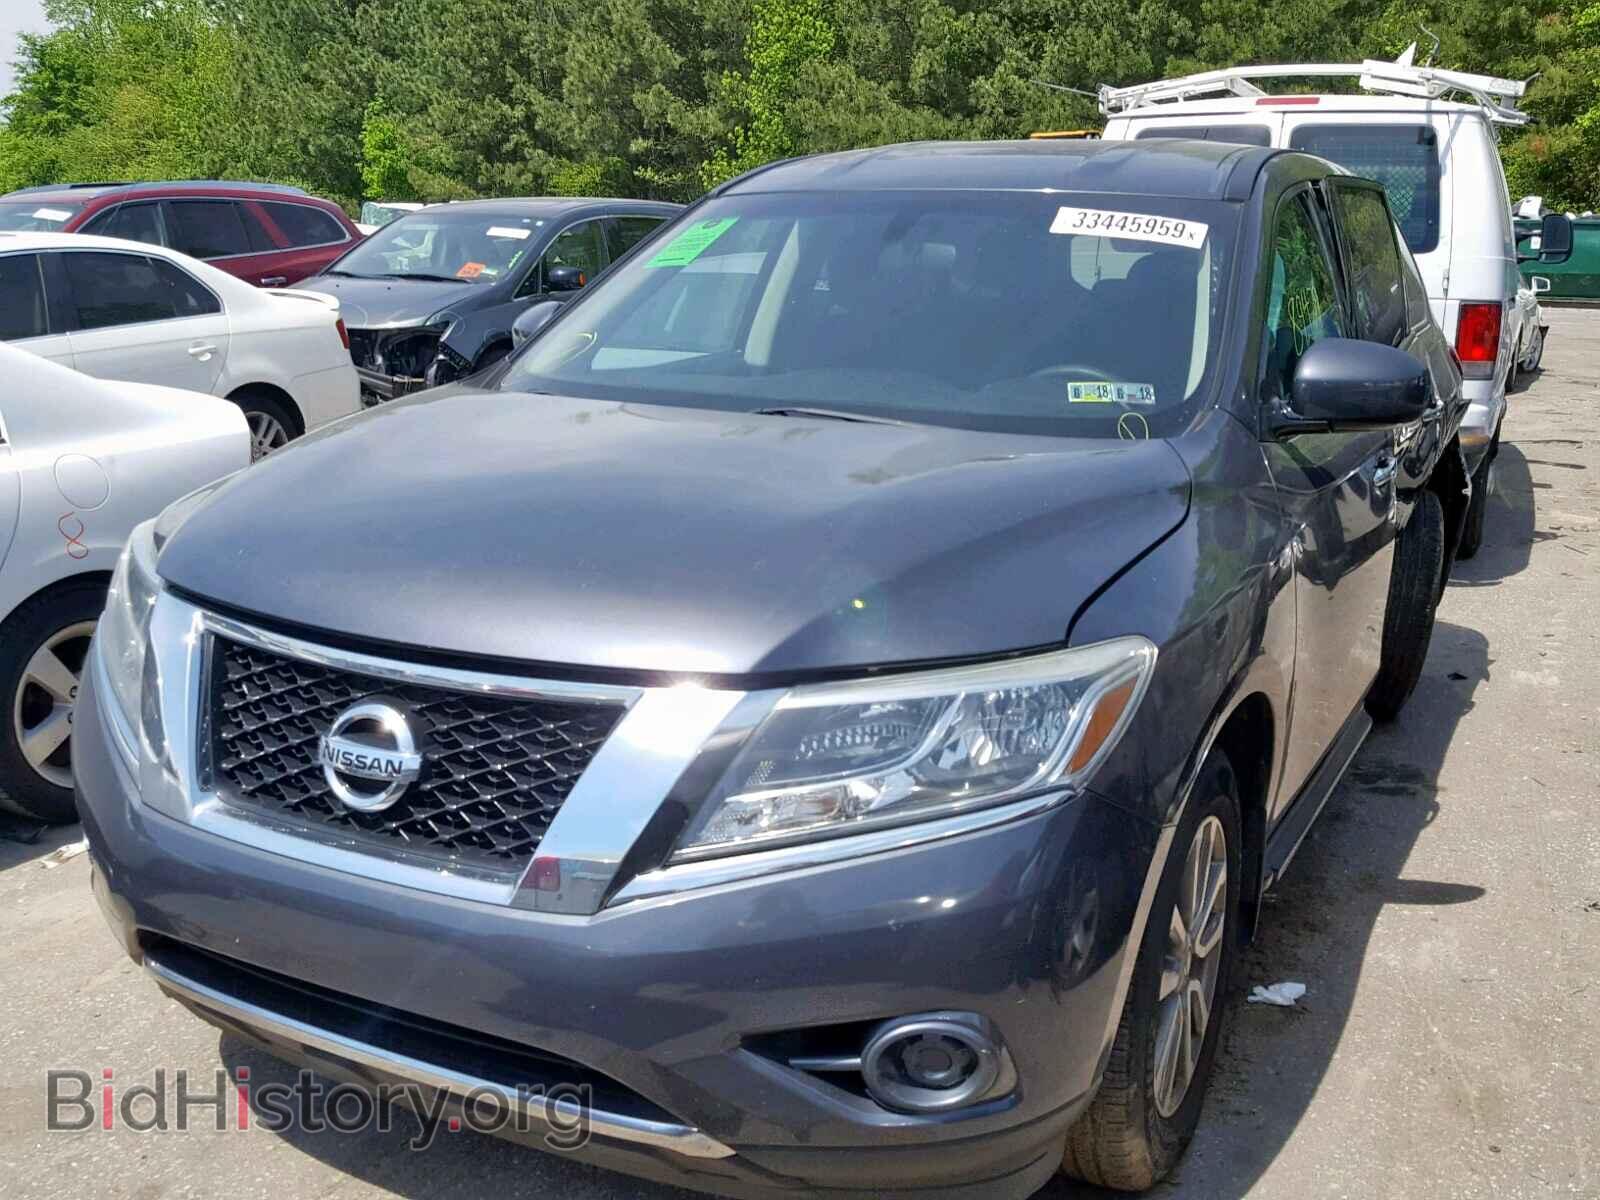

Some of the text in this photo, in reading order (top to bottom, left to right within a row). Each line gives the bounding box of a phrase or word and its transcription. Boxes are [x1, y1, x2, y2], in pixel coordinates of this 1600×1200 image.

[1072, 211, 1186, 239] 33445959
[1096, 384, 1109, 399] 18
[1139, 387, 1152, 401] 18
[322, 740, 404, 775] NISSAN
